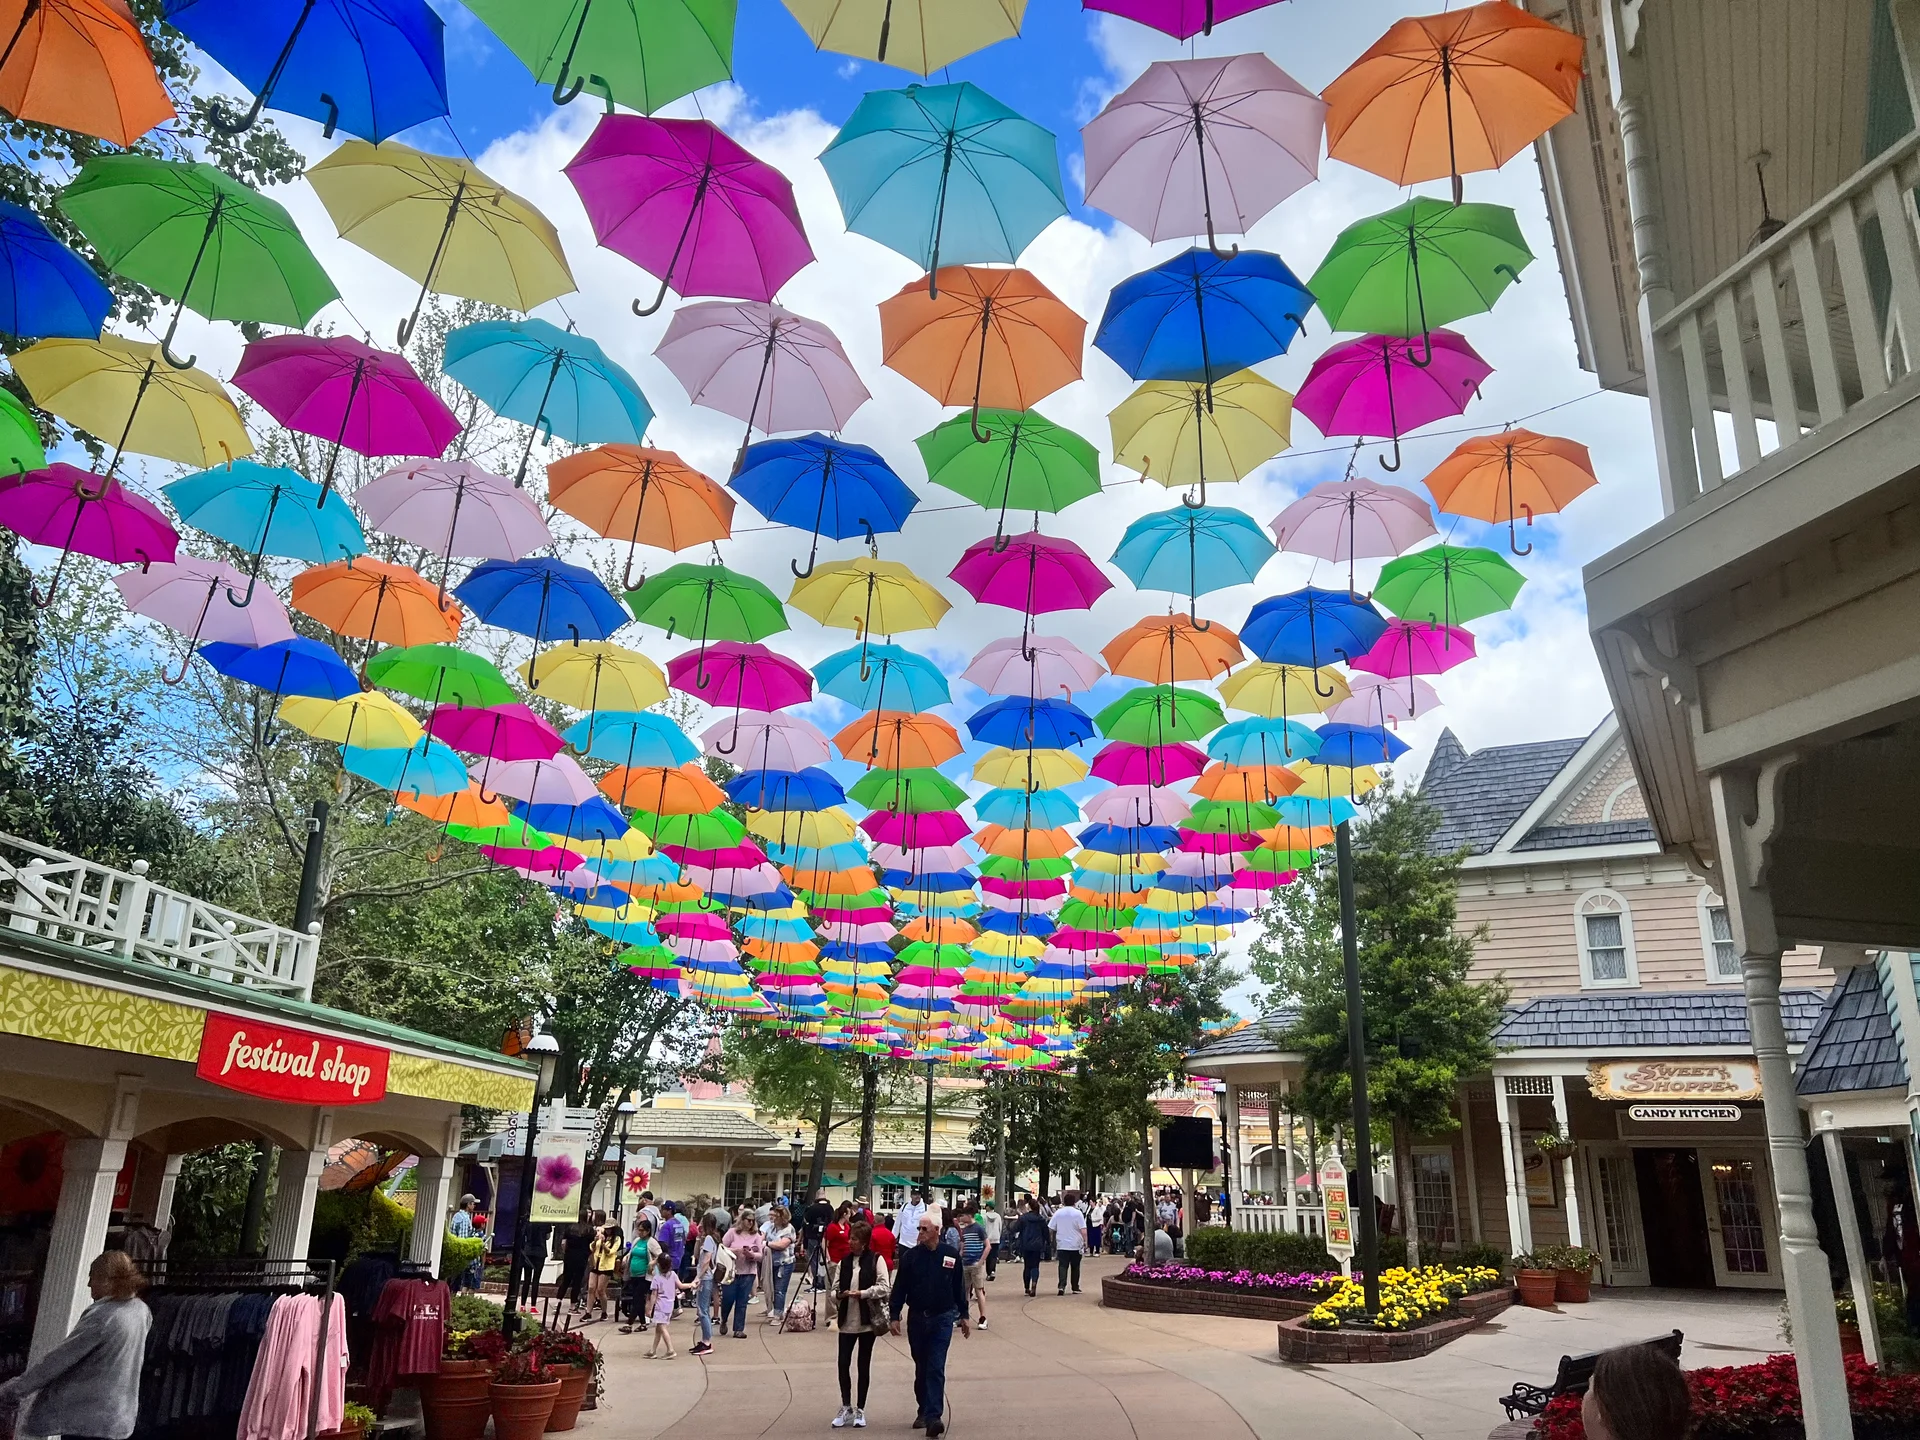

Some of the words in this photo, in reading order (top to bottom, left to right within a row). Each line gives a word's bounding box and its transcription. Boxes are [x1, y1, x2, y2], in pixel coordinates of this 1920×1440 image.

[219, 1031, 320, 1078] festival
[320, 1045, 371, 1097] shop
[1625, 1062, 1731, 1081] SWEET
[1620, 1077, 1739, 1094] SHOPPE
[1634, 1109, 1676, 1118] CANDY
[1679, 1109, 1736, 1118] KITCHEN
[540, 1204, 570, 1214] Bloom!
